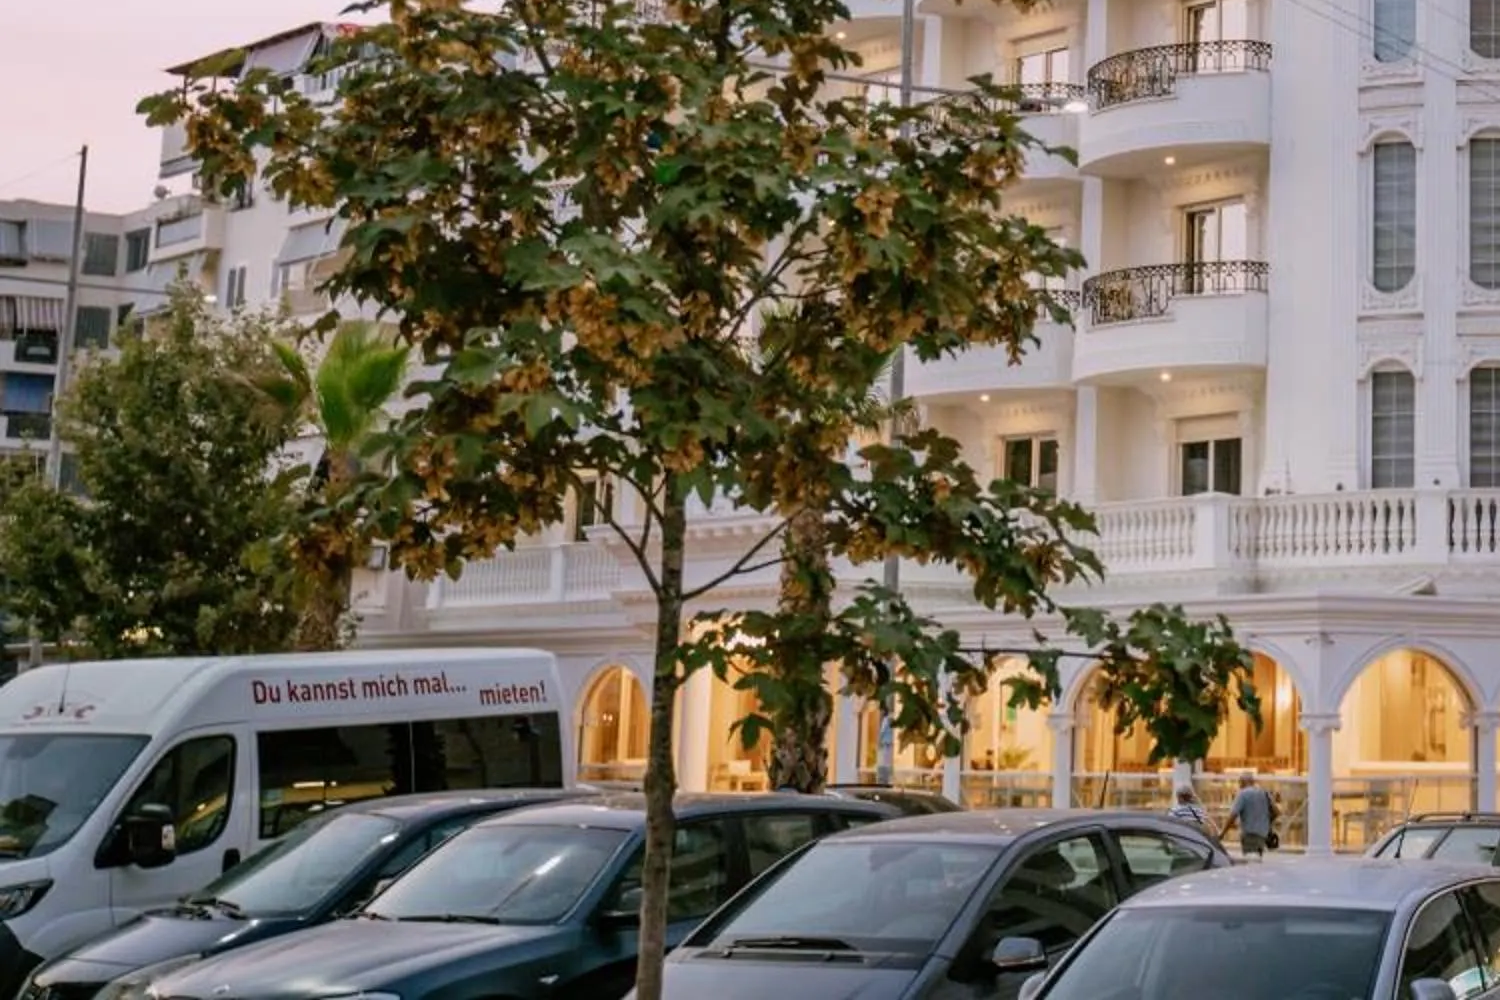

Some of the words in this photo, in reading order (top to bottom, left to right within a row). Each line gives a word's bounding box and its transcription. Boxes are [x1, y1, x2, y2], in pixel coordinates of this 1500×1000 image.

[252, 680, 281, 704] Du
[287, 677, 356, 703] kannst
[361, 672, 409, 698] mich
[413, 671, 467, 696] mal...
[479, 681, 548, 706] mieten!
